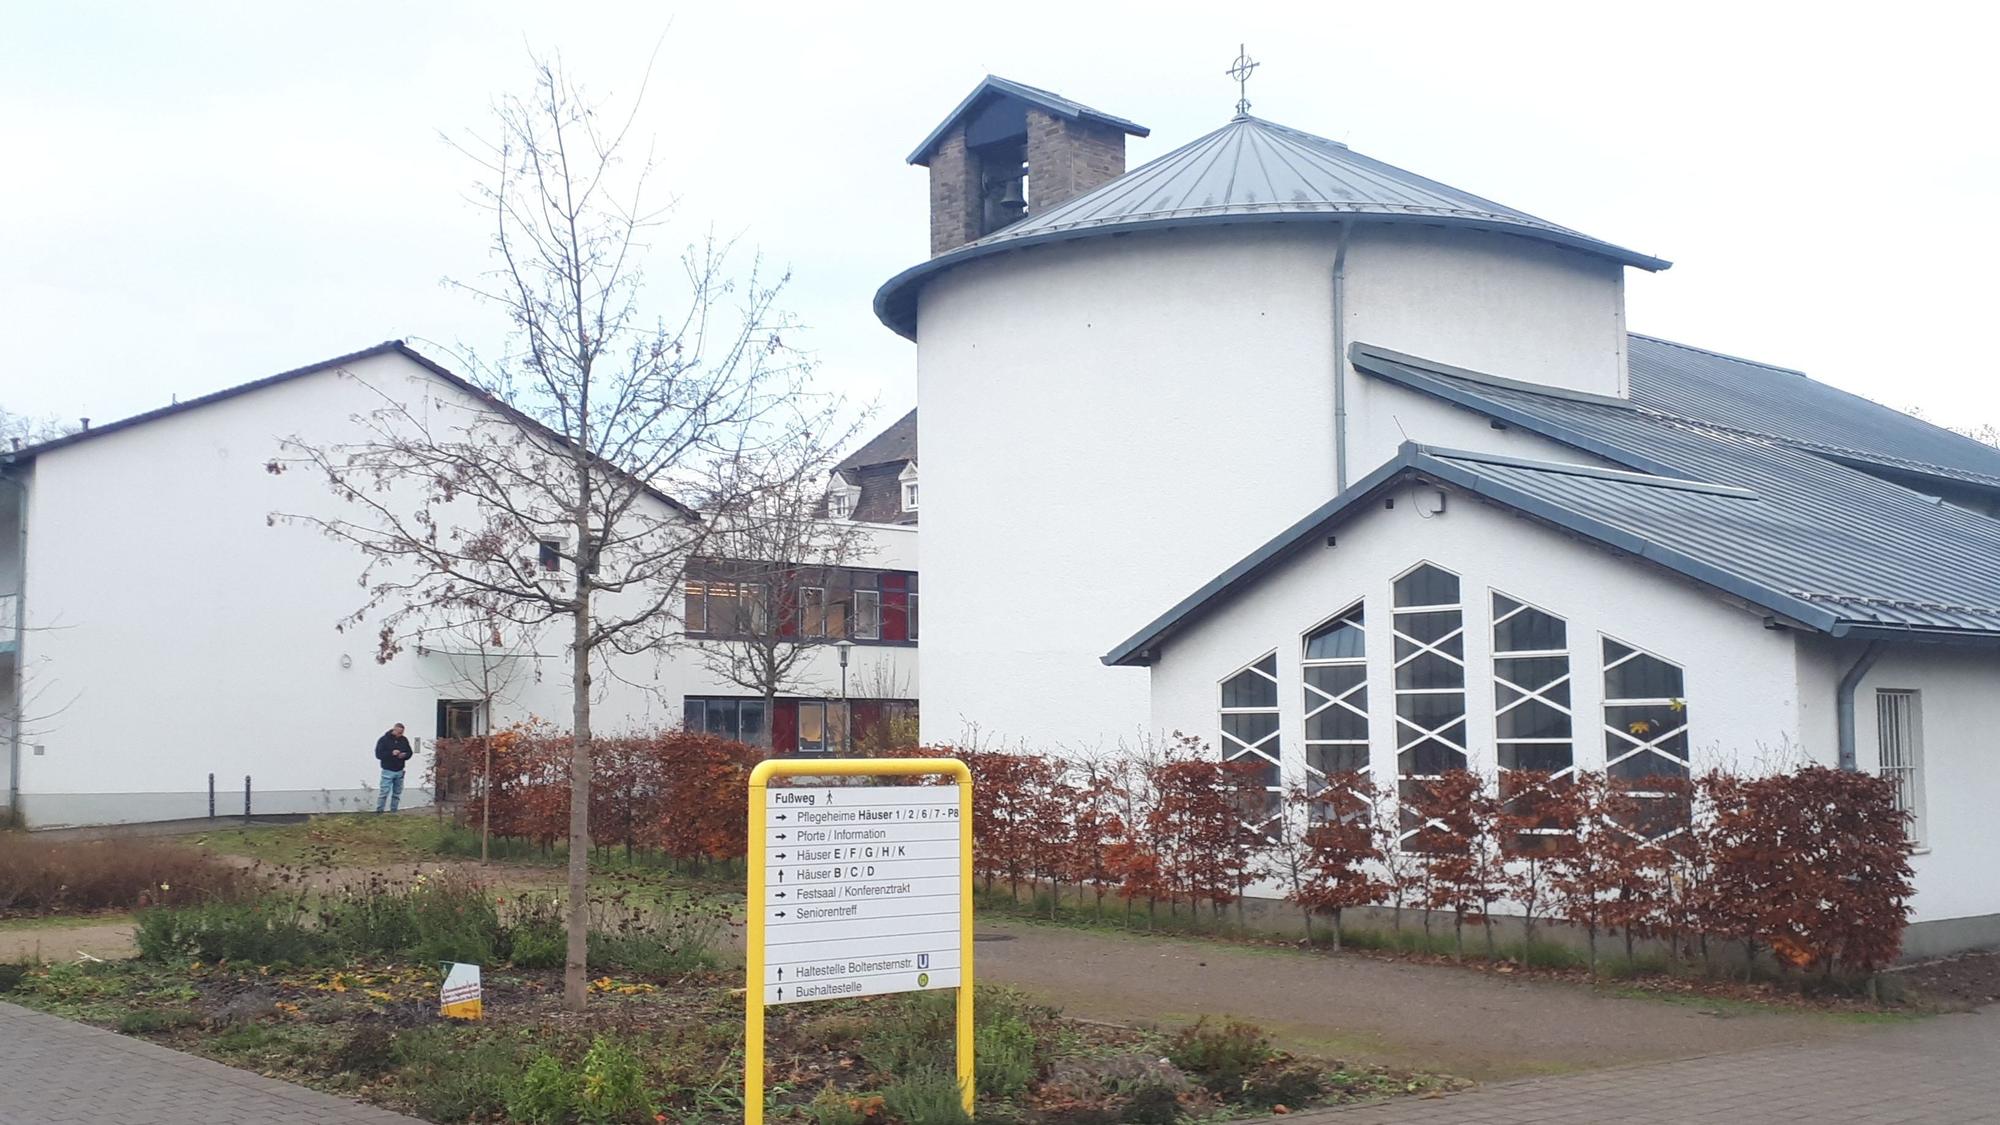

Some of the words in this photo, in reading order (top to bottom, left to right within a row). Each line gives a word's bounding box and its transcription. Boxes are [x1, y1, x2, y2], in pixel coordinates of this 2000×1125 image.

[775, 793, 815, 805] Fußweg
[797, 811, 856, 824] Pflegeheime
[858, 809, 893, 820] Häuser
[896, 810, 900, 819] 1
[908, 810, 914, 819] 2
[921, 809, 928, 819] 6
[935, 809, 941, 818] 7
[797, 830, 826, 842] Pforte
[827, 829, 832, 842] /
[834, 828, 886, 840] Information
[797, 849, 831, 861] Häuser
[834, 848, 841, 859] E
[843, 847, 848, 860] /
[850, 847, 857, 858] F
[858, 847, 863, 859] /
[865, 846, 873, 858] G
[875, 846, 880, 858] /
[882, 846, 890, 857] H
[891, 846, 896, 858] /
[898, 845, 905, 856] K
[797, 869, 831, 880] Häuser
[834, 867, 841, 878] B
[843, 866, 848, 879] /
[850, 866, 858, 877] C
[860, 866, 865, 878] /
[867, 866, 875, 876] D
[797, 887, 836, 900] Festsaal
[838, 886, 843, 898] /
[844, 883, 910, 897] Konferenztrakt
[796, 904, 857, 919] Seniorentreff
[796, 964, 846, 978] Haltestelle
[848, 959, 912, 974] Boltensternstr.
[796, 982, 862, 997] Bushaltestelle
